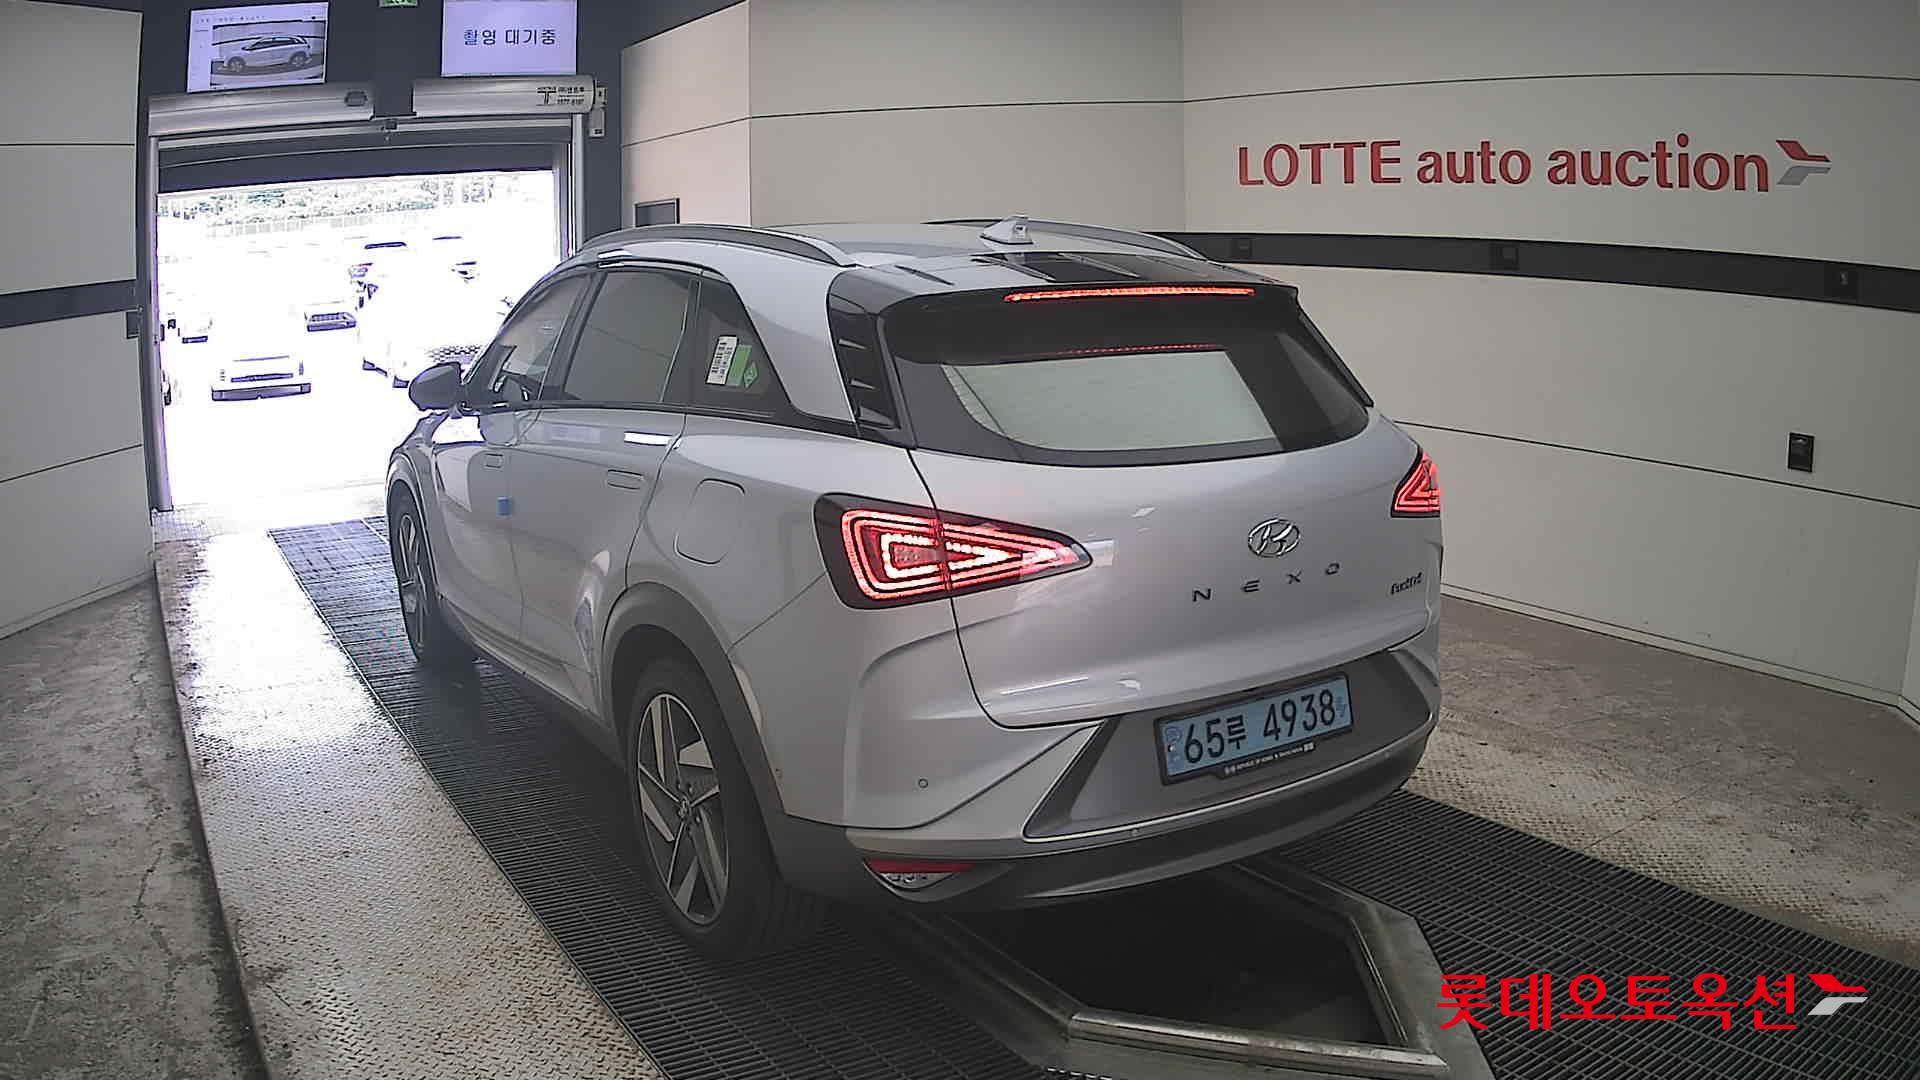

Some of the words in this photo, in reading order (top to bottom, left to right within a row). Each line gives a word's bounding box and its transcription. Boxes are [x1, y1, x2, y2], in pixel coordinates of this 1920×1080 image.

[464, 29, 496, 46] 촬영
[505, 29, 557, 45] 대기중
[1238, 140, 1401, 186] LOTTE
[1416, 140, 1532, 185] auto
[1547, 133, 1769, 193] auction
[1192, 562, 1341, 602] NEXO
[1263, 689, 1336, 741] 4938
